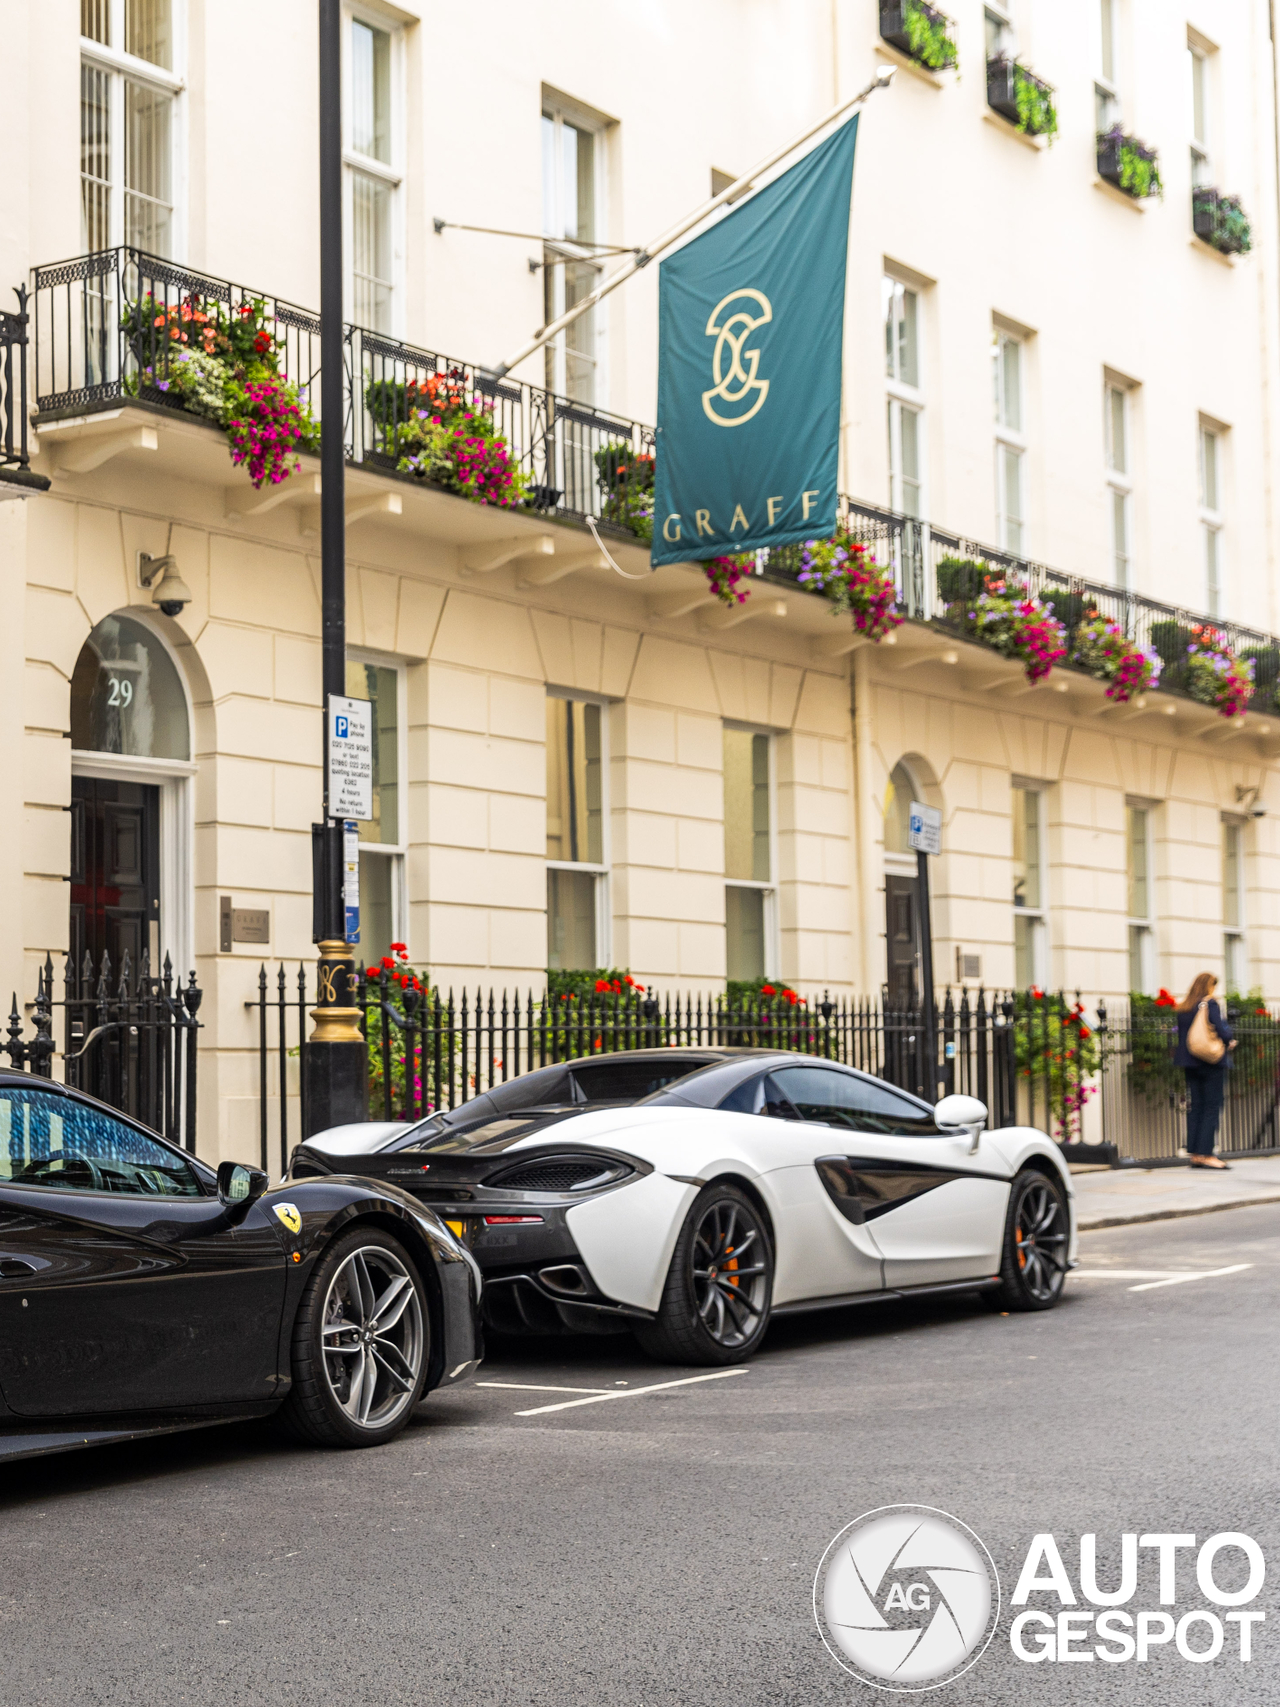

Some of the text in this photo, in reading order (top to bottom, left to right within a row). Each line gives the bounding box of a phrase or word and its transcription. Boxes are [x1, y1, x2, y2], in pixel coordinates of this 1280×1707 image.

[662, 490, 820, 542] GRAFF
[108, 677, 133, 708] 29
[338, 718, 347, 736] P
